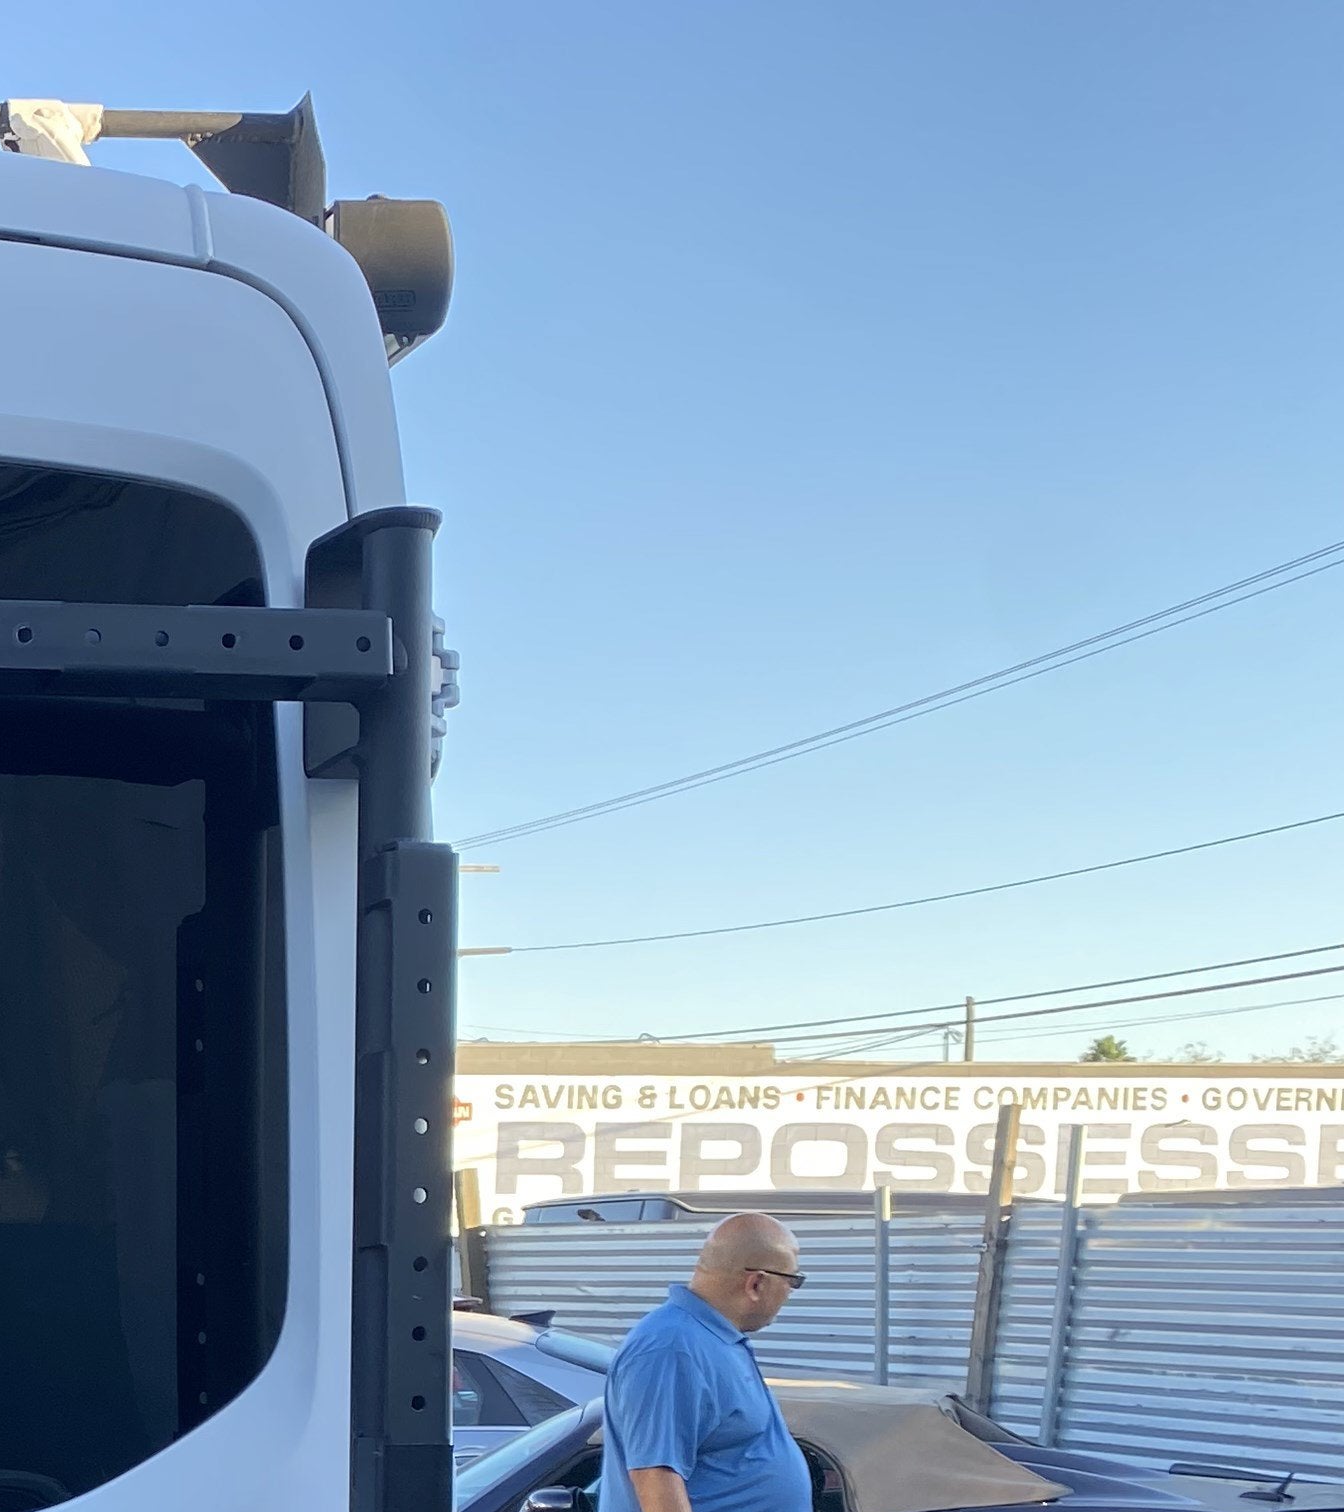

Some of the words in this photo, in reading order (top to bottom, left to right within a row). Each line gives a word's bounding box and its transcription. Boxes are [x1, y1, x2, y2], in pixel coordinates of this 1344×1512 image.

[494, 1083, 623, 1110] SAVING
[637, 1085, 658, 1110] &
[668, 1084, 782, 1110] LOANS
[816, 1085, 961, 1111] FINANCE
[973, 1086, 1169, 1112] COMPANIES
[1201, 1086, 1344, 1112] GOVERN
